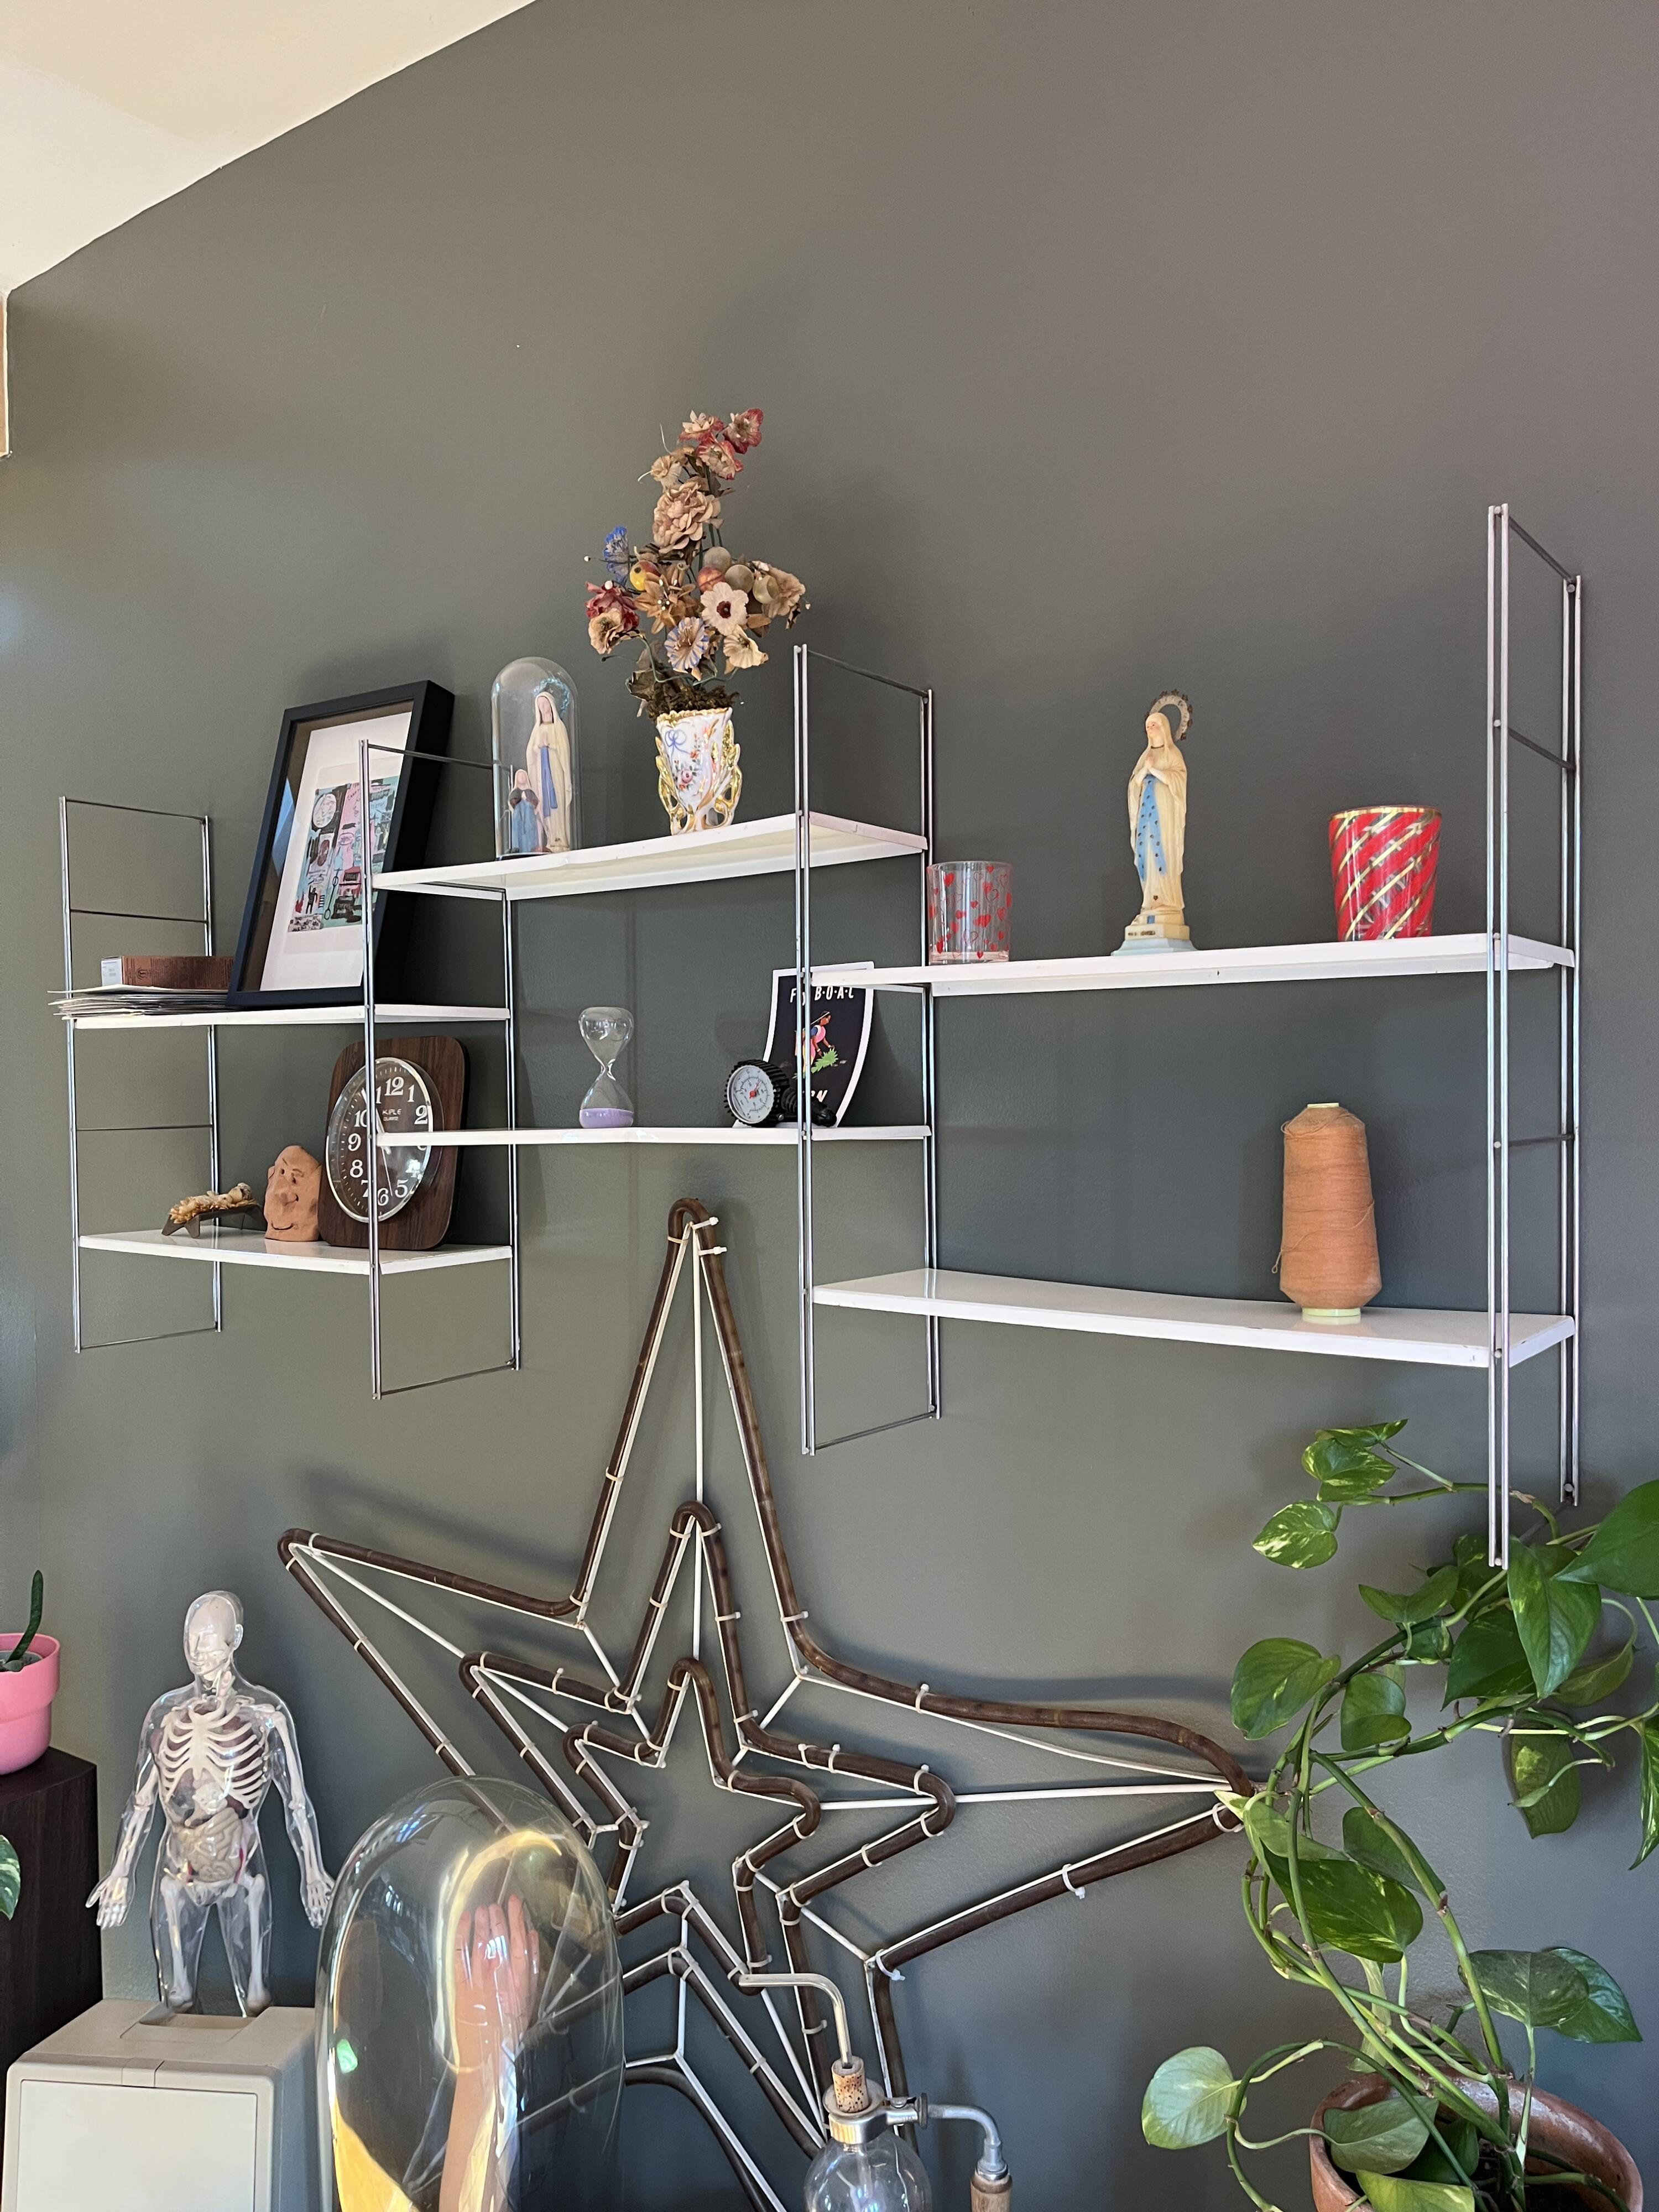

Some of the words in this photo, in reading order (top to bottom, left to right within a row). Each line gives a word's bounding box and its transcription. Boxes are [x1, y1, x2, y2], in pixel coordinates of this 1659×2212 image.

[384, 1077, 404, 1096] 12
[408, 1084, 415, 1102] 1
[354, 1109, 368, 1128] 10
[414, 1105, 428, 1125] 2
[348, 1133, 361, 1151] 9
[349, 1160, 363, 1178] 8
[377, 1188, 389, 1206] 6
[395, 1179, 409, 1198] 5
